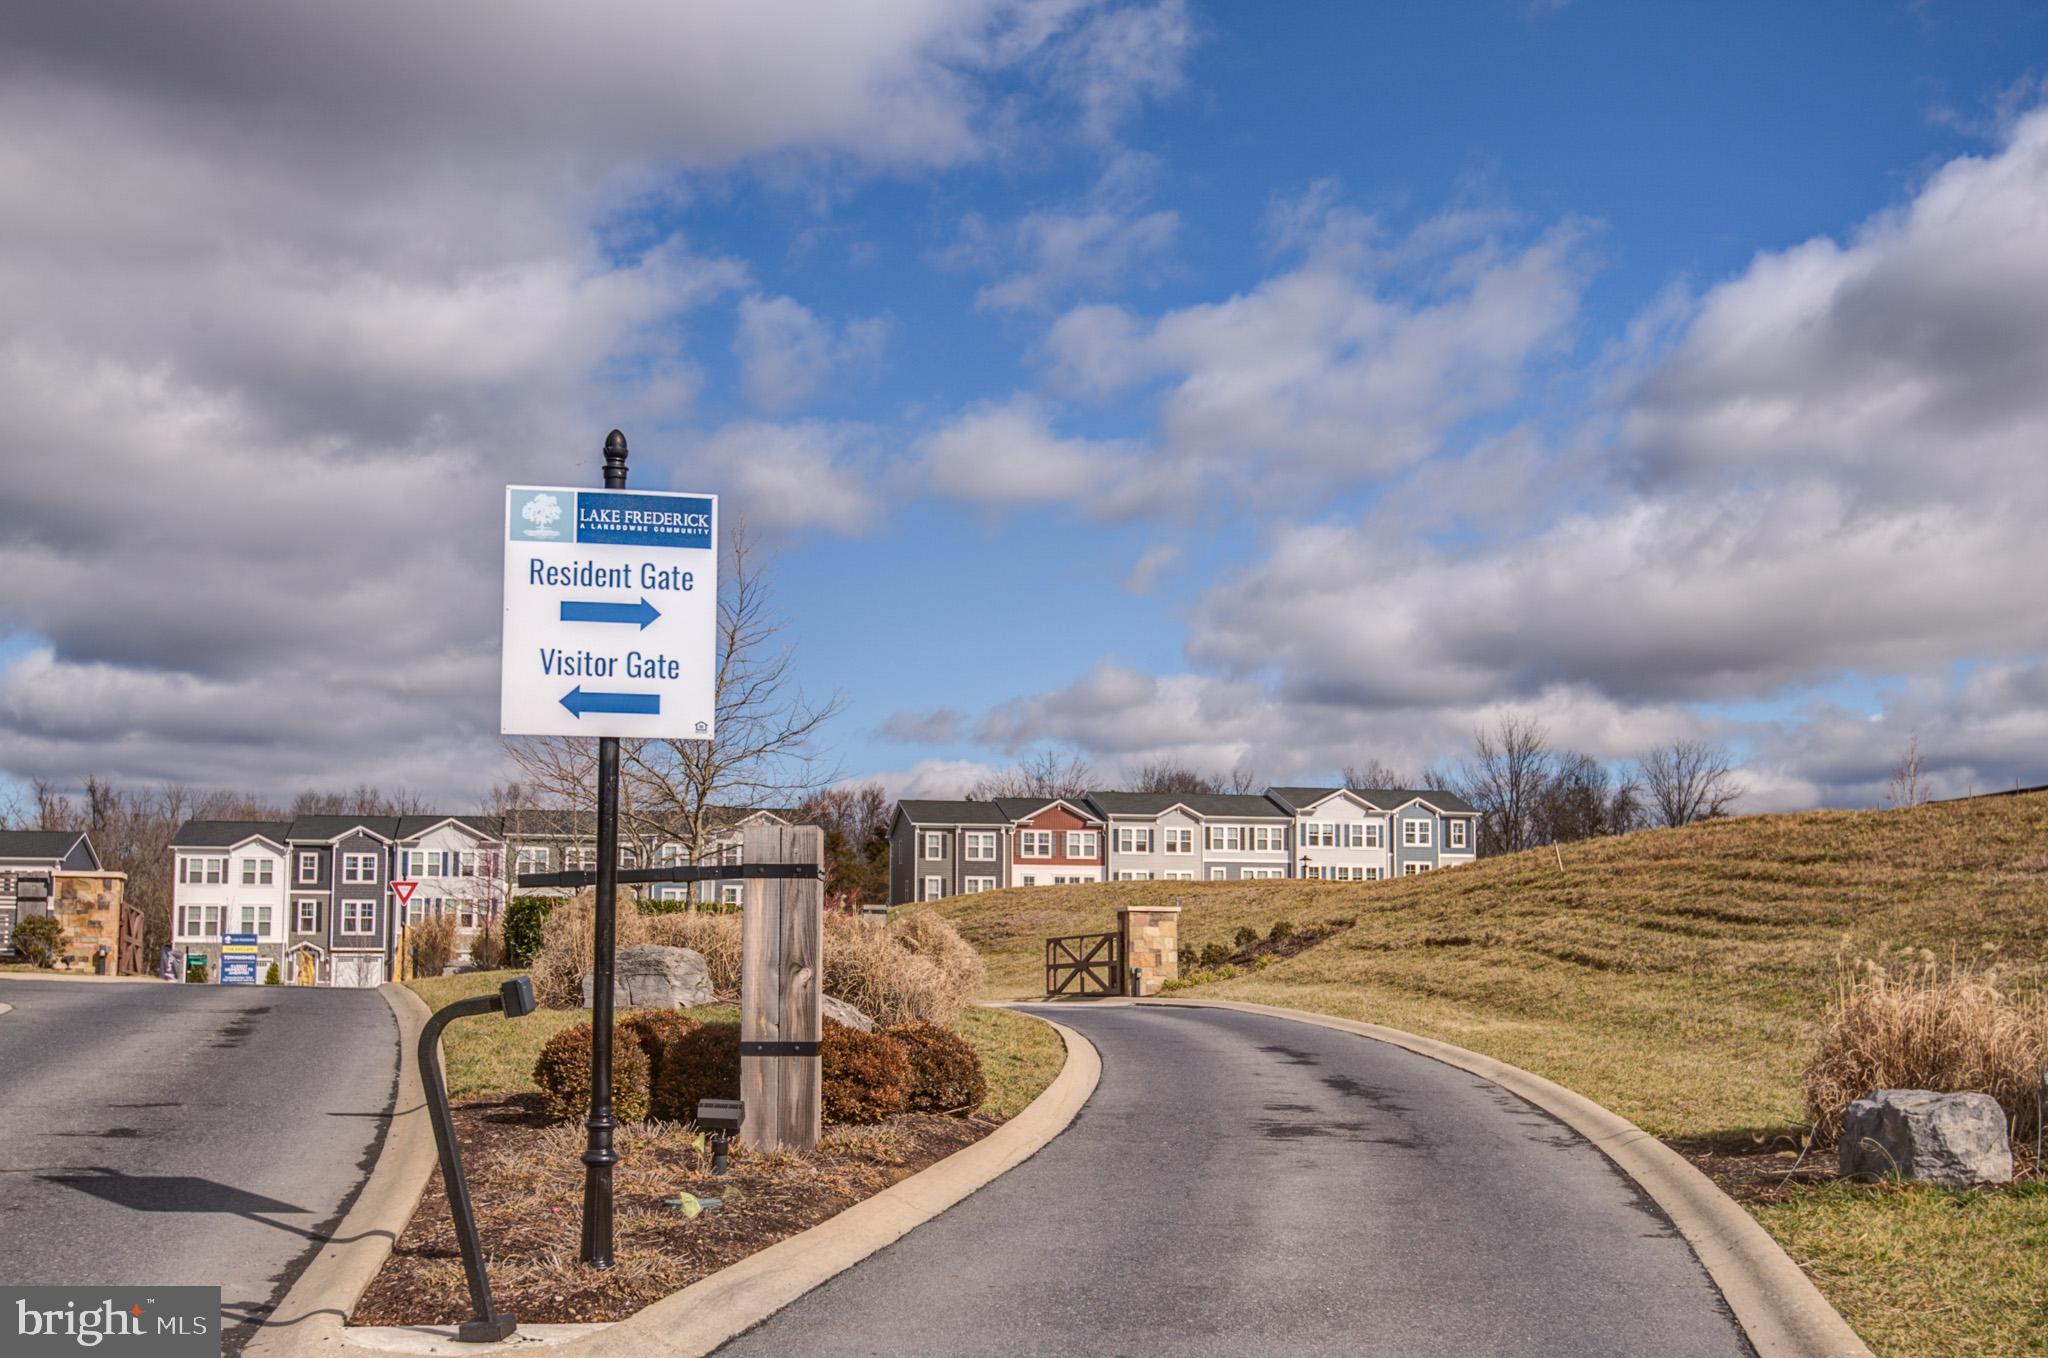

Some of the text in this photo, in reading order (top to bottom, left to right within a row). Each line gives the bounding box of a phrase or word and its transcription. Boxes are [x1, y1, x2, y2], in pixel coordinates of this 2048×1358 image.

[580, 508, 710, 528] LAKE FREDERICK
[591, 524, 649, 532] LANSDOWNE
[653, 526, 710, 535] COMMUNITY
[529, 558, 694, 592] Resident Gate
[539, 648, 680, 680] Visitor Gate
